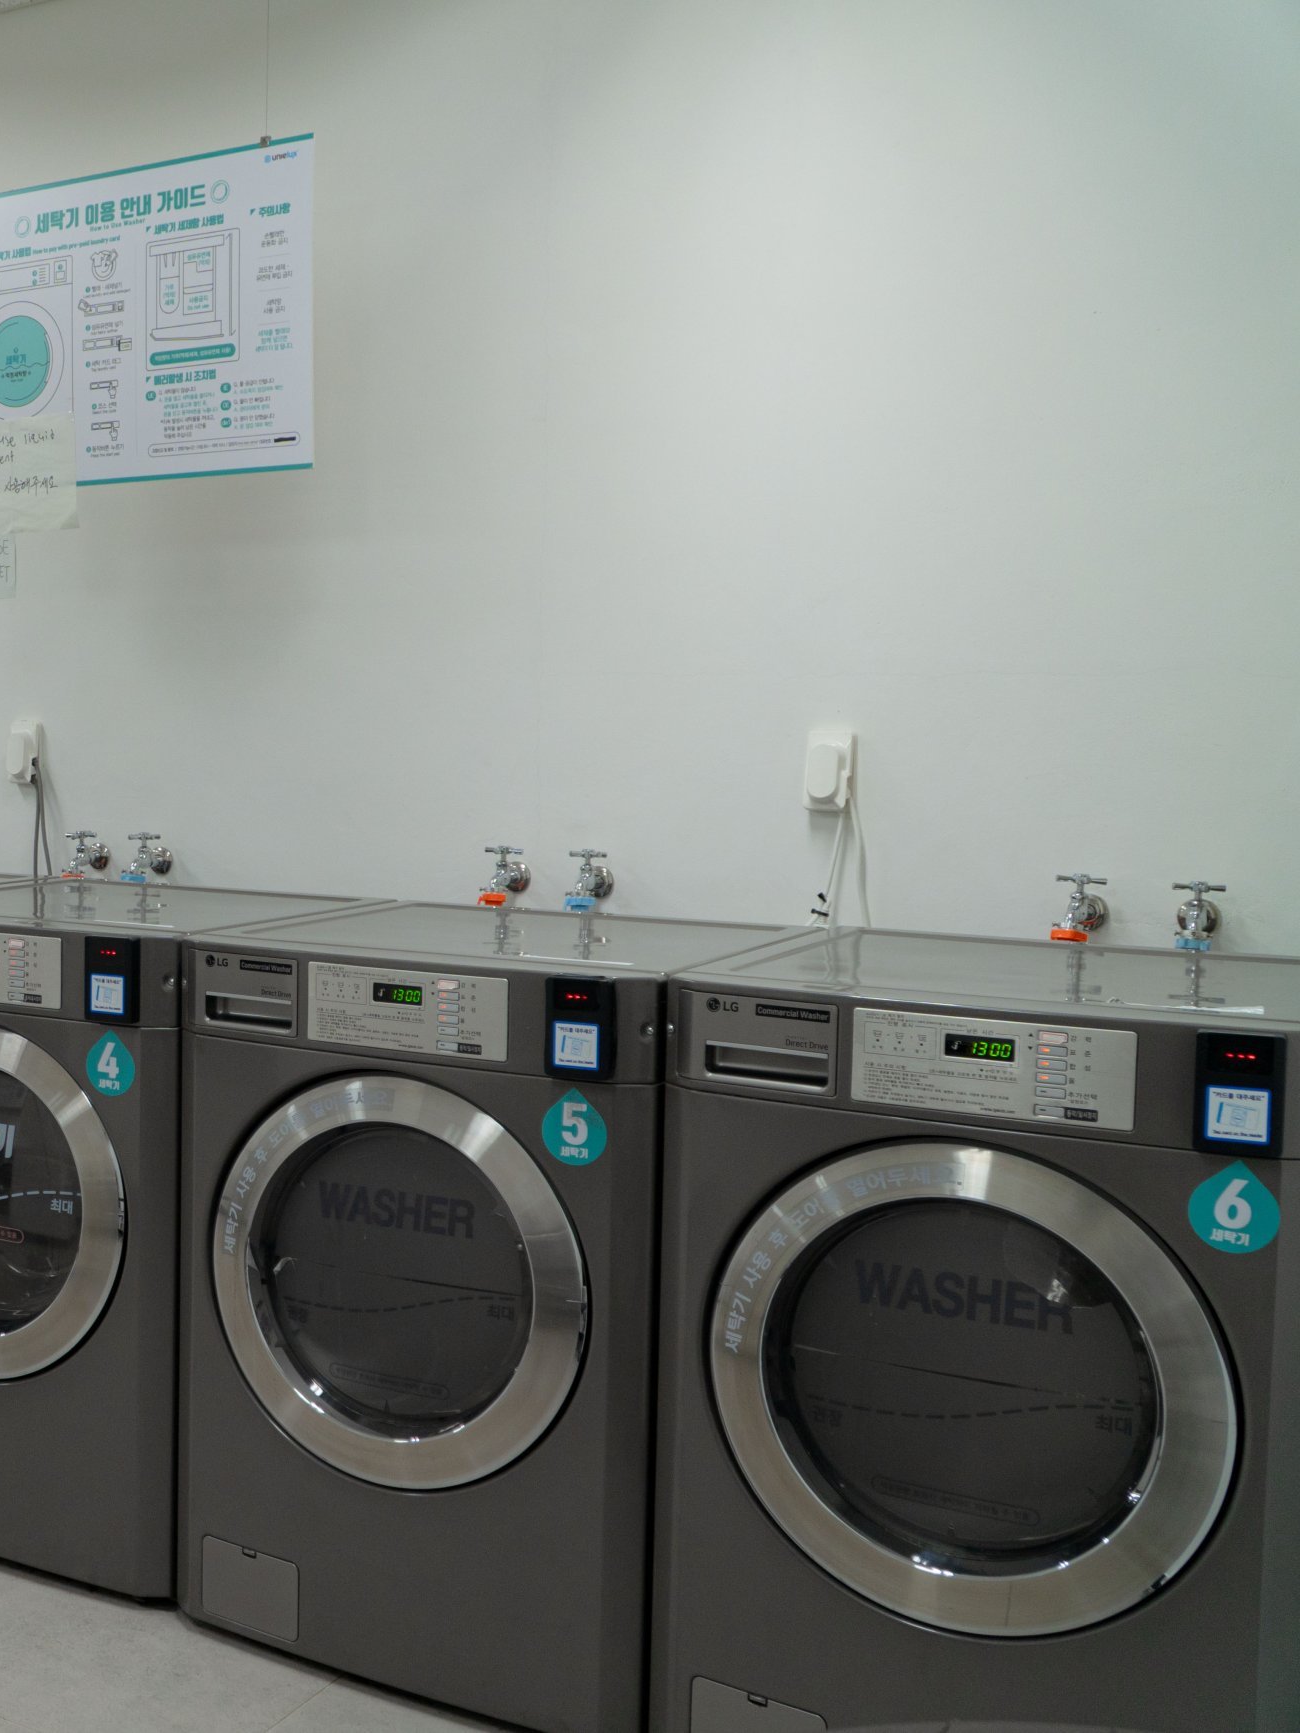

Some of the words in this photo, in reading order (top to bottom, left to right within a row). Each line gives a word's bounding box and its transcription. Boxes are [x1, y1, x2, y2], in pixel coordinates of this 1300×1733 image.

[35, 207, 79, 235] 세탁기
[85, 200, 115, 226] 이용
[120, 194, 151, 219] 안내
[157, 184, 206, 213] 가이드
[90, 224, 101, 232] How
[124, 217, 146, 227] Washer
[5, 354, 27, 366] 세탁기
[217, 958, 228, 967] LG
[723, 1002, 739, 1012] LG
[757, 1006, 799, 1018] Commercial
[800, 1011, 829, 1022] Washer
[785, 1038, 807, 1049] Direct
[809, 1041, 829, 1051] Drive
[97, 1042, 120, 1078] 4
[98, 1078, 120, 1091] 세탁기
[561, 1102, 588, 1145] 5
[560, 1145, 589, 1160] 세탁기
[50, 1197, 74, 1216] 최대
[223, 1202, 244, 1255] 세탁기
[236, 1167, 258, 1199] 사용
[254, 1147, 269, 1165] 후
[318, 1180, 476, 1240] WASHER
[1214, 1178, 1252, 1230] 6
[1210, 1228, 1250, 1247] 세탁기
[724, 1292, 753, 1354] 세탁기
[743, 1251, 772, 1289] 사용
[769, 1229, 789, 1250] 후
[854, 1258, 1074, 1336] WASHER
